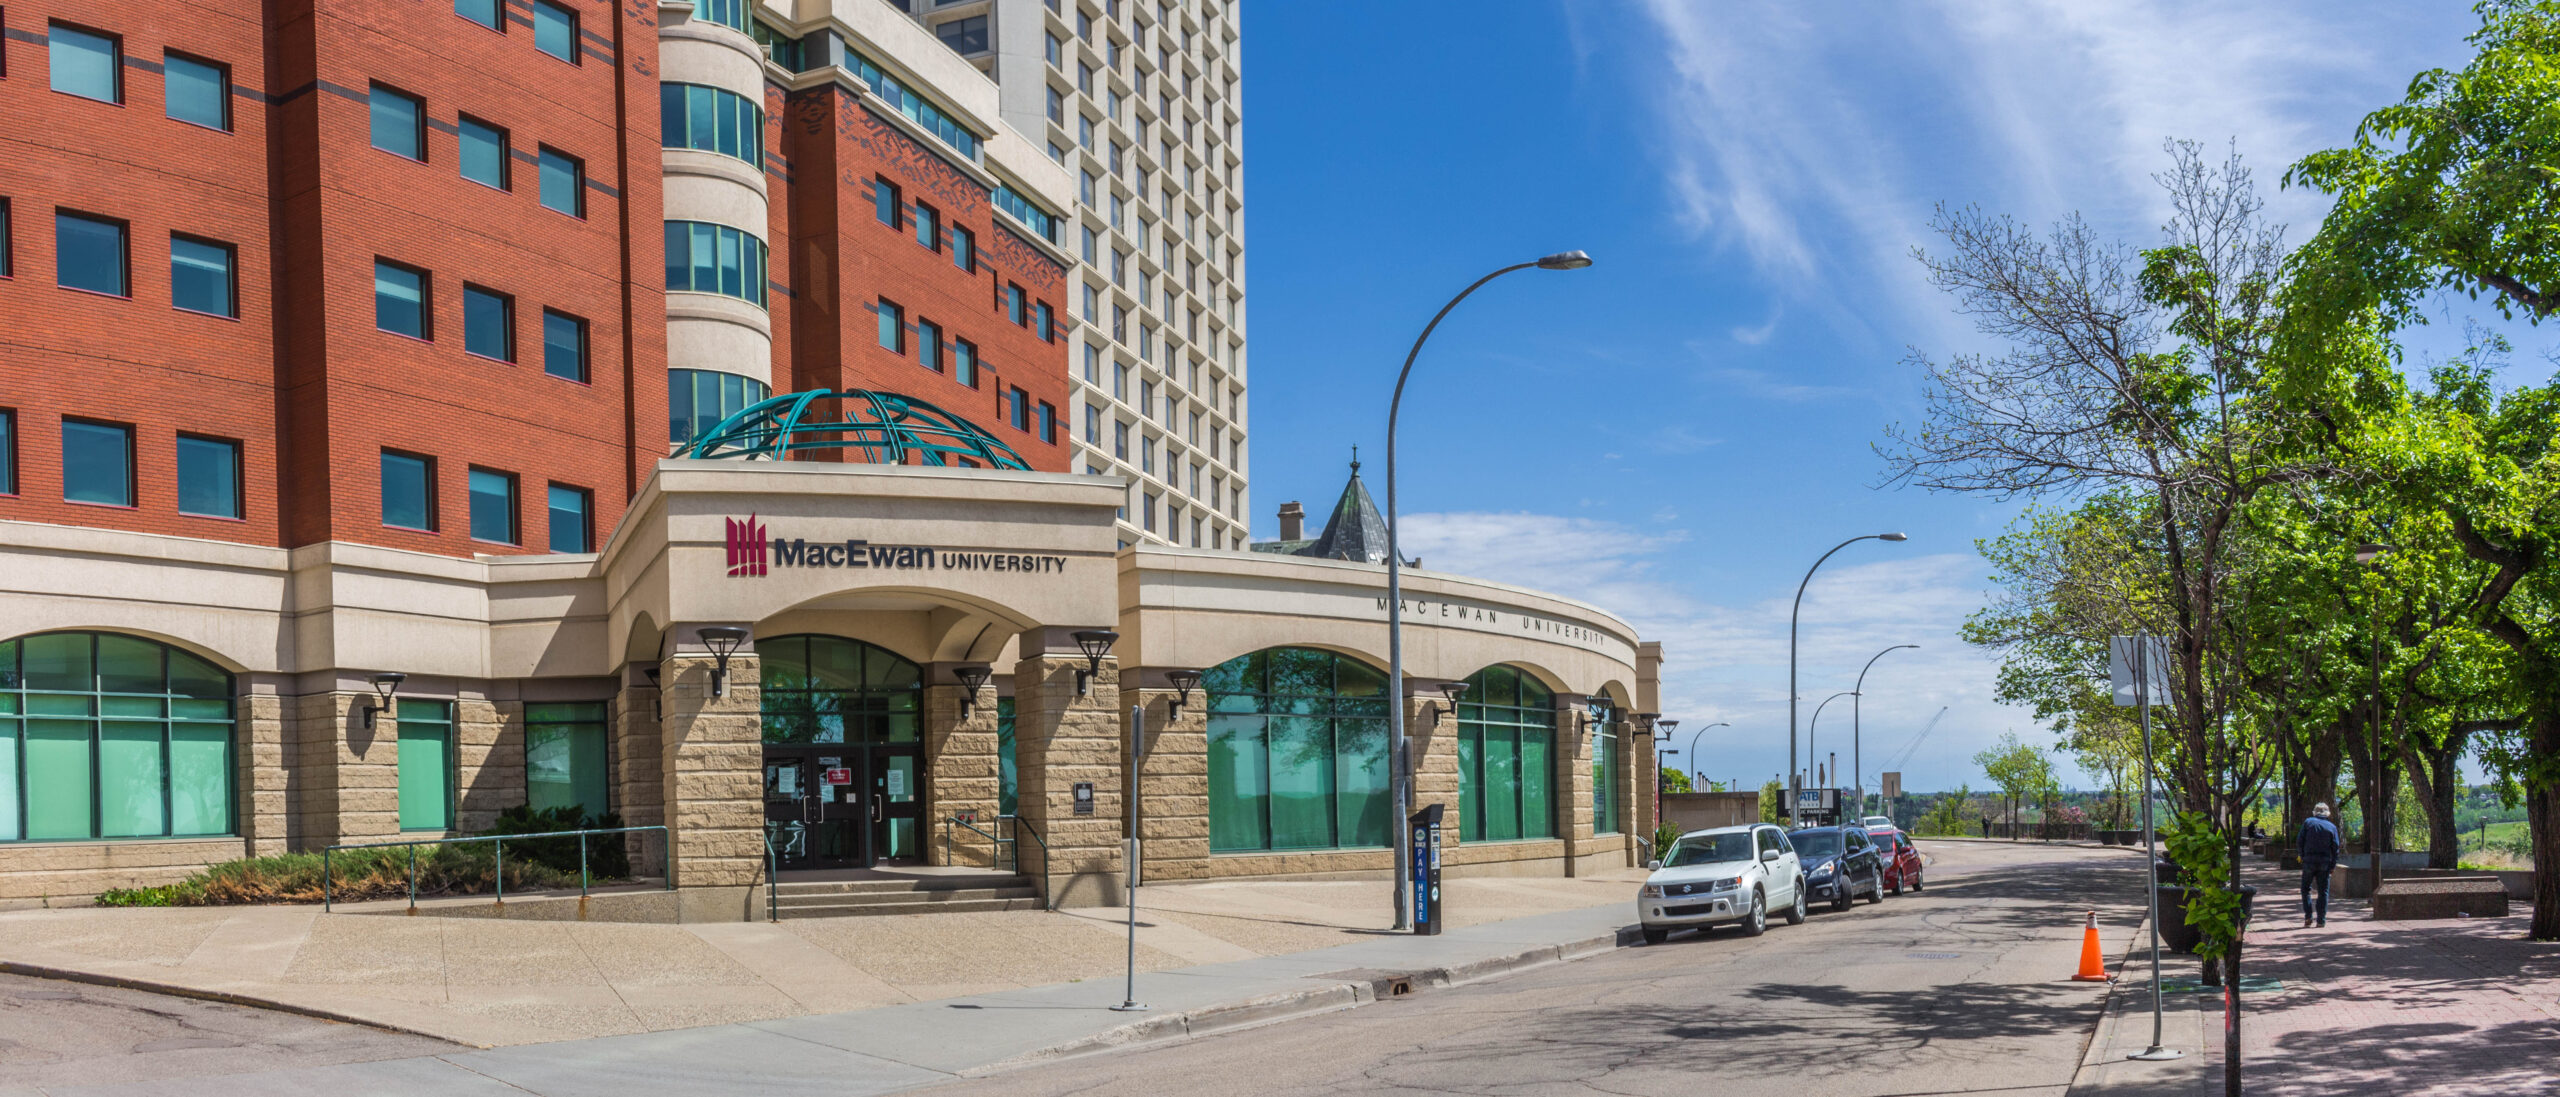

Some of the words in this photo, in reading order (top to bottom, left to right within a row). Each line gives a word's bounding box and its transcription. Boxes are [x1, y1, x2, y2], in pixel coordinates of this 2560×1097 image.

[775, 538, 935, 569] MacEwan
[943, 553, 1067, 574] UNIVERSITY
[1523, 616, 1604, 645] UNIVERSITY
[1800, 791, 1819, 801] ATB
